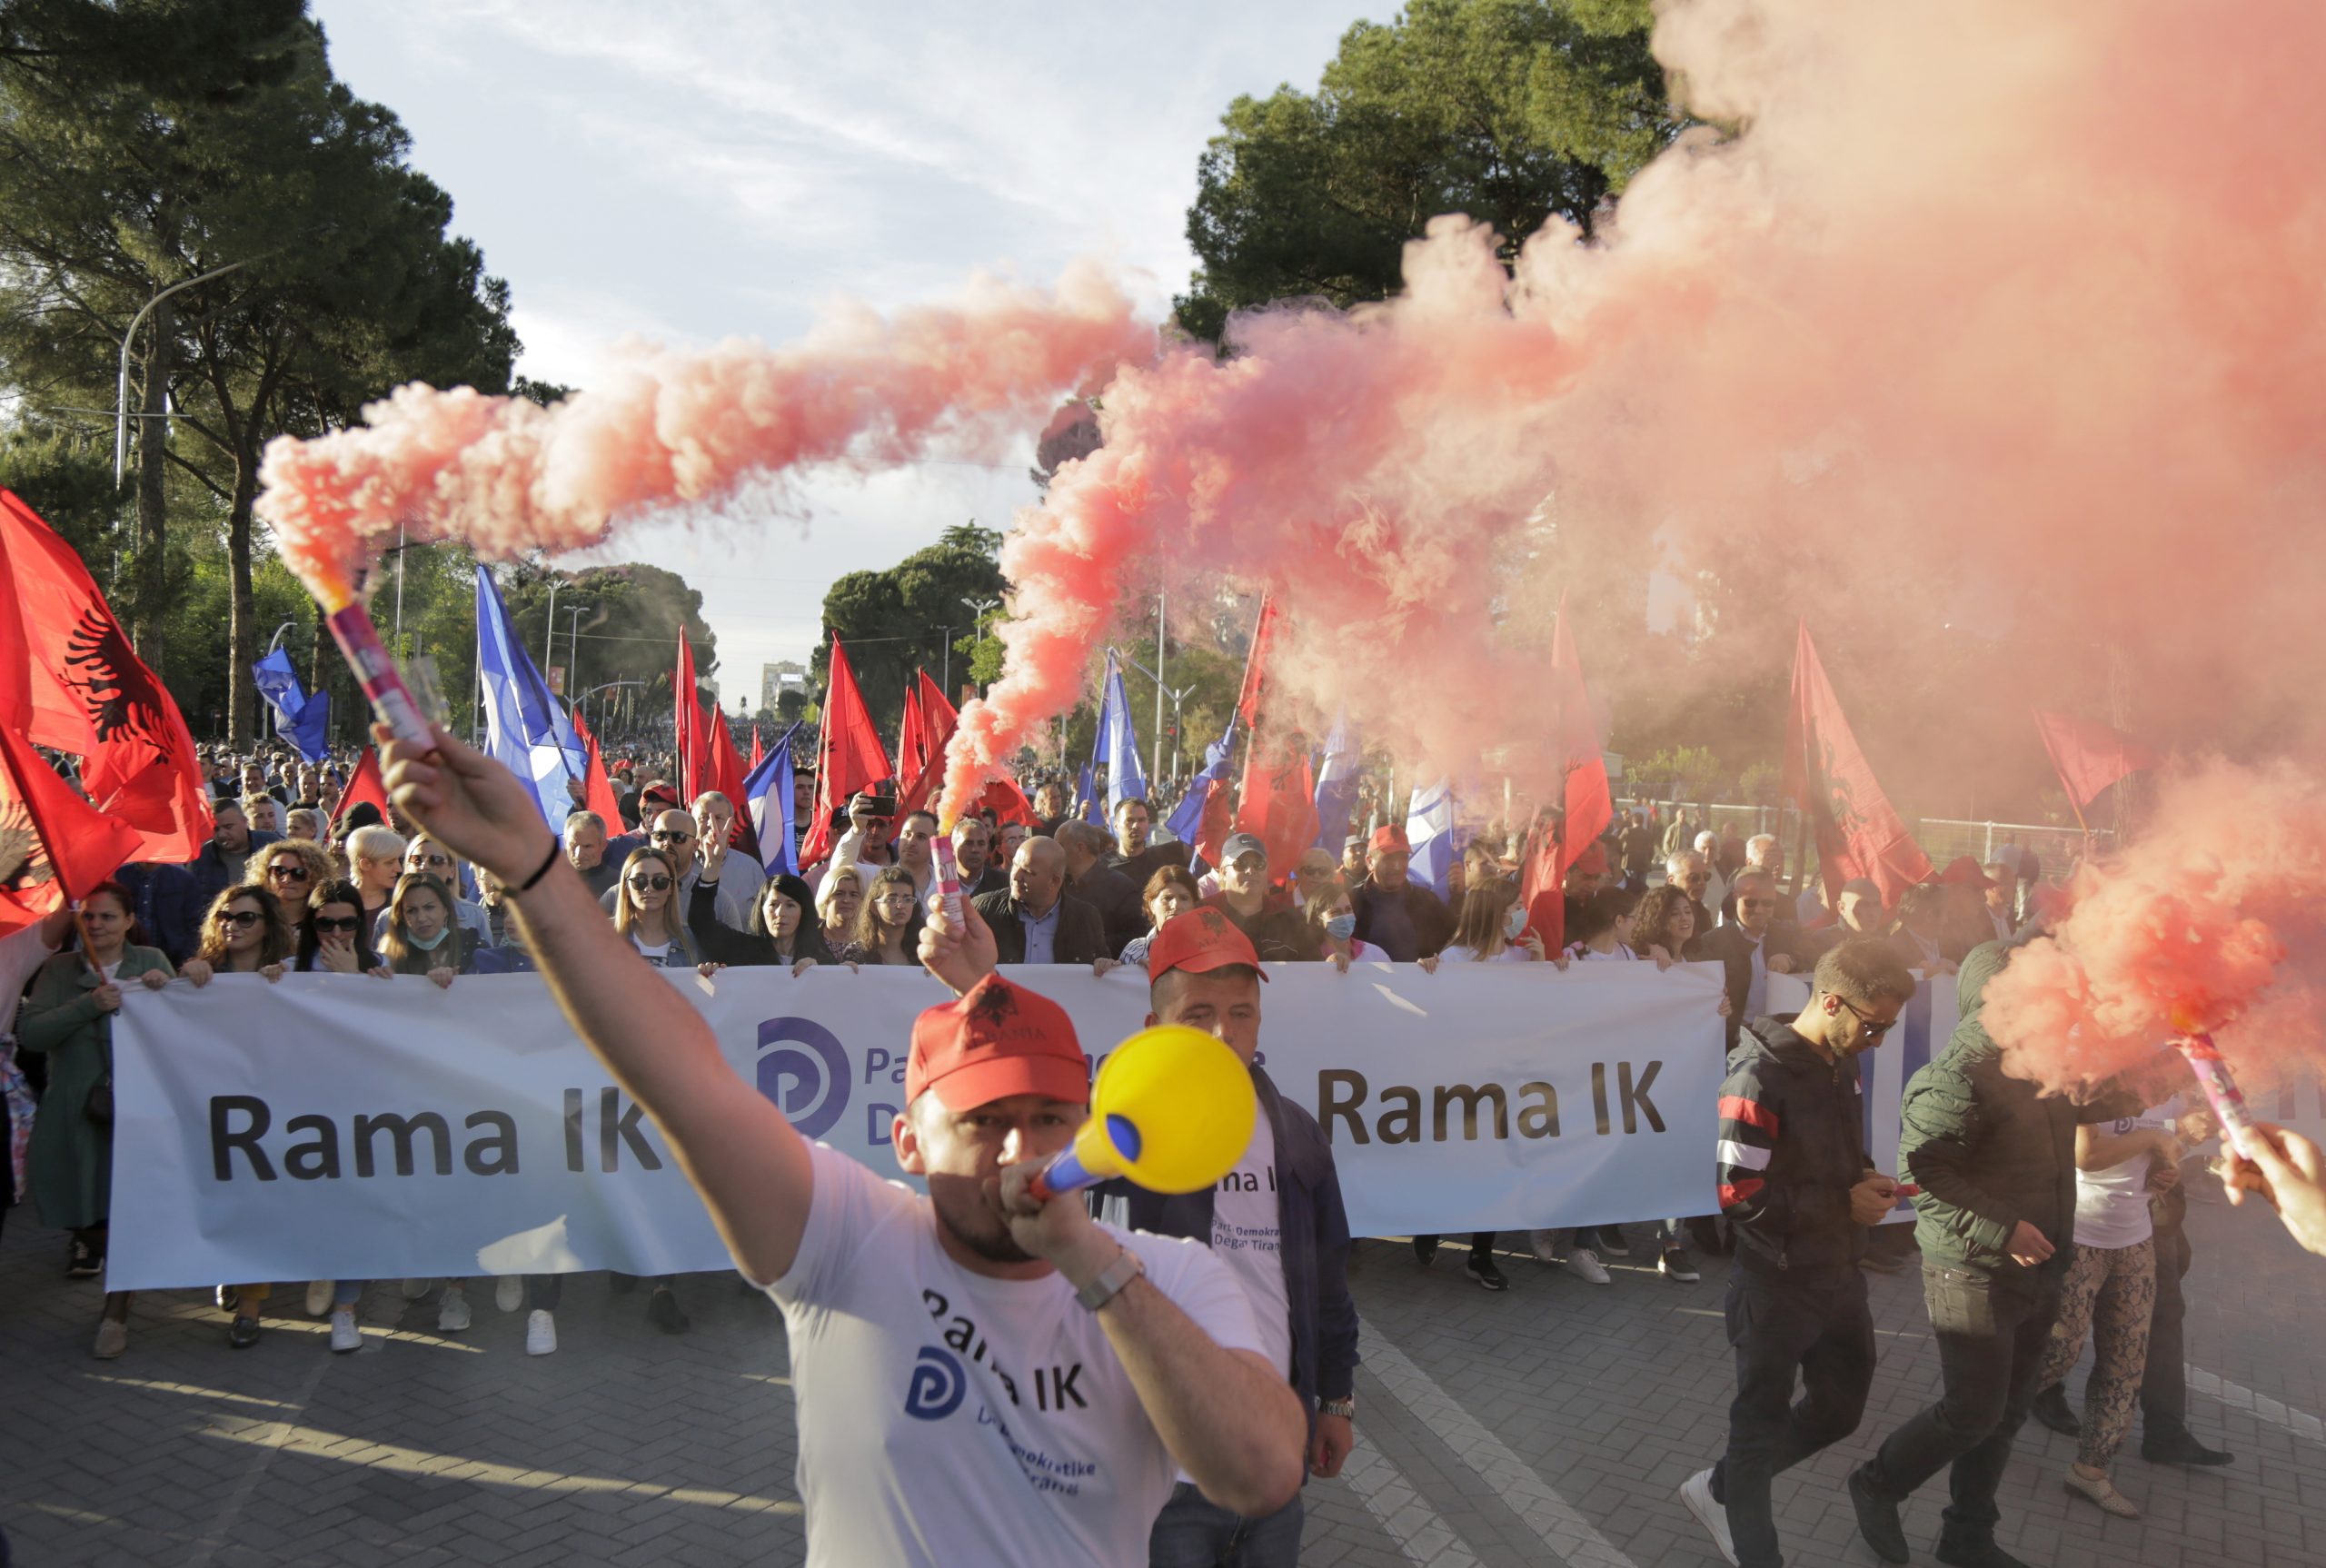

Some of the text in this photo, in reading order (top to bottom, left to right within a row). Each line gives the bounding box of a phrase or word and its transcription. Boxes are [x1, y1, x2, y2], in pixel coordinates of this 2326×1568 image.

[209, 1086, 664, 1182] Rama IK
[1318, 1059, 1666, 1146] Rama IK
[1251, 1239, 1279, 1251] Tiran
[1034, 1363, 1088, 1412] IK
